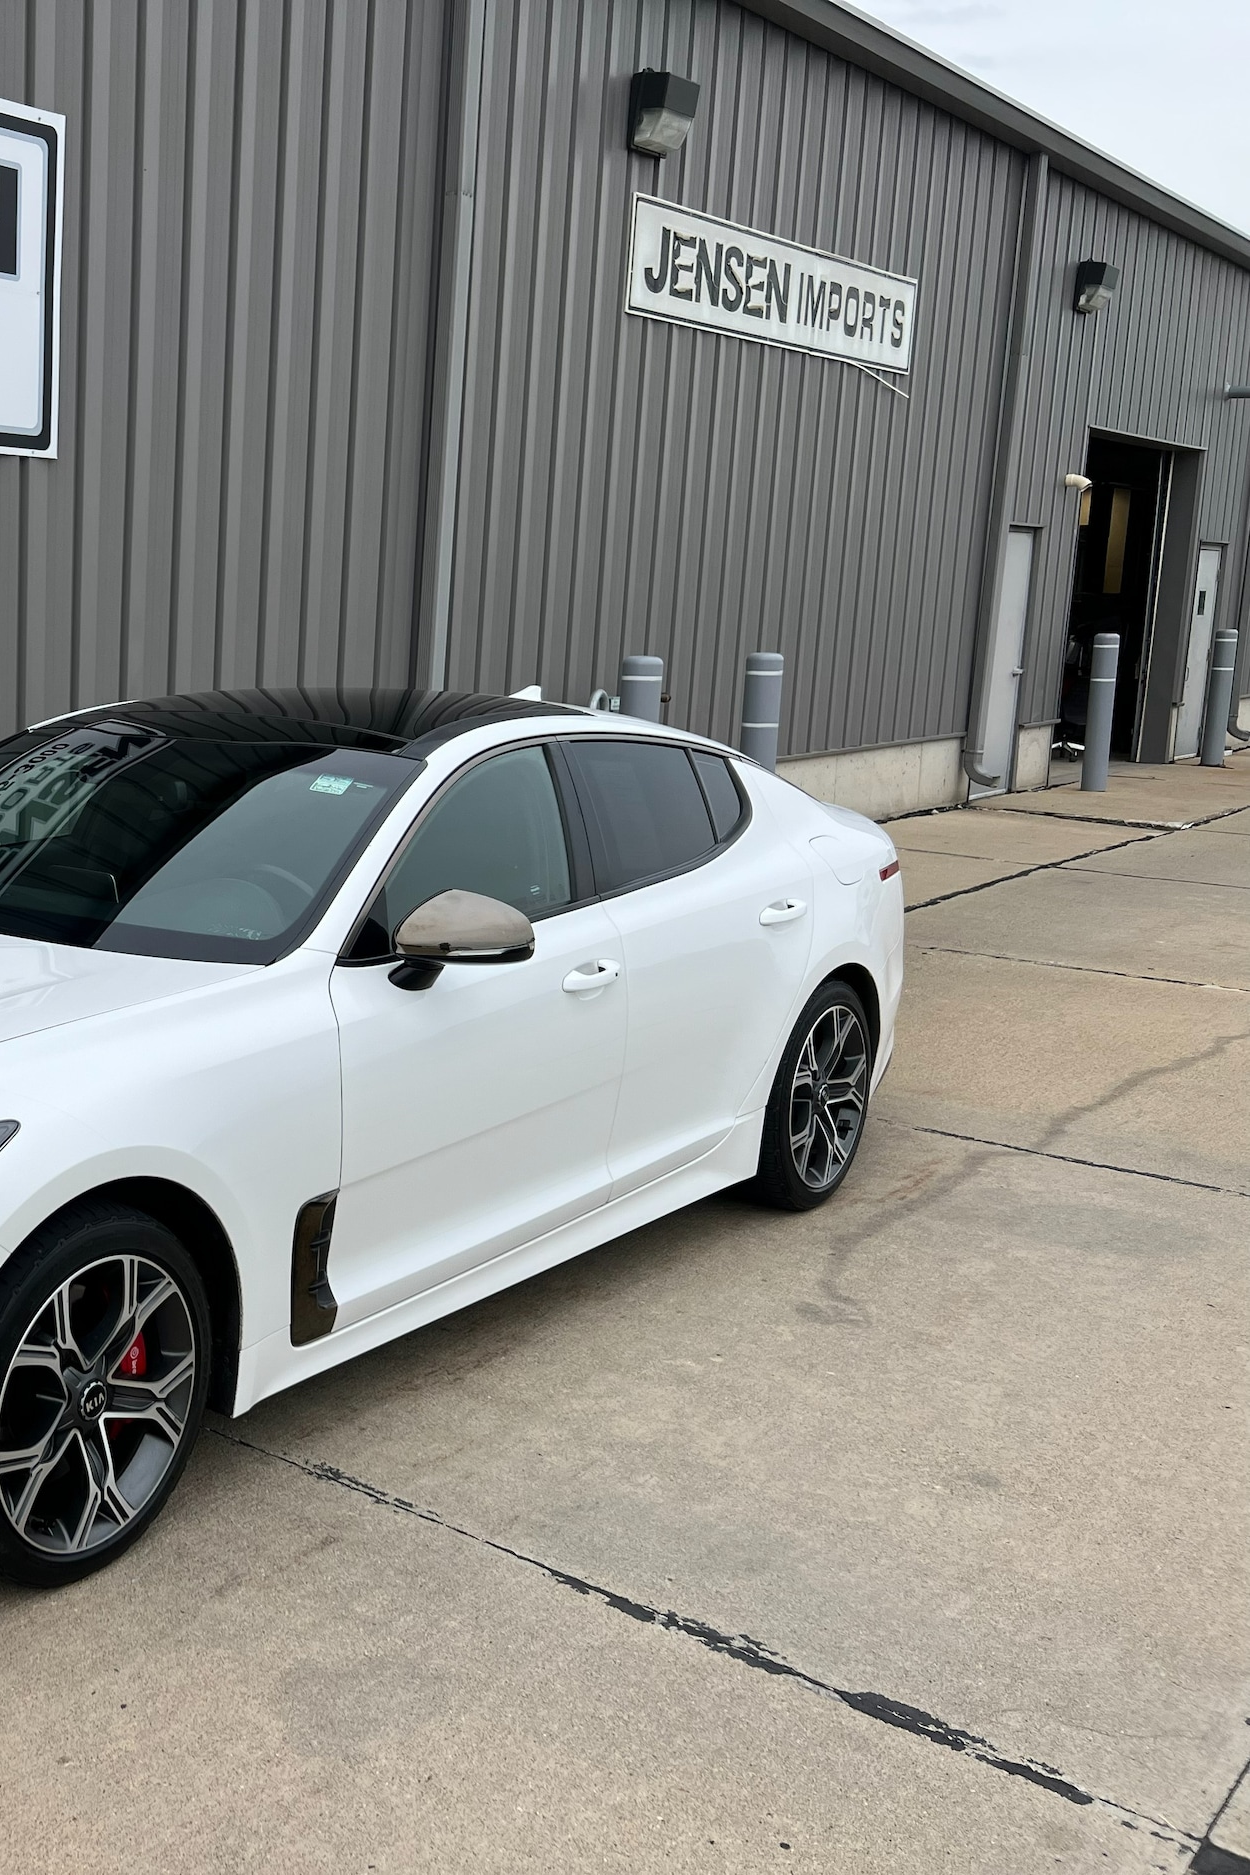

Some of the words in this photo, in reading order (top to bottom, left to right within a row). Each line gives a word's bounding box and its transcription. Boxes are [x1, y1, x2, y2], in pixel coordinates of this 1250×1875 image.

[643, 225, 792, 324] JENSEN
[796, 271, 906, 348] IMPORTS
[85, 1391, 106, 1413] KIA
